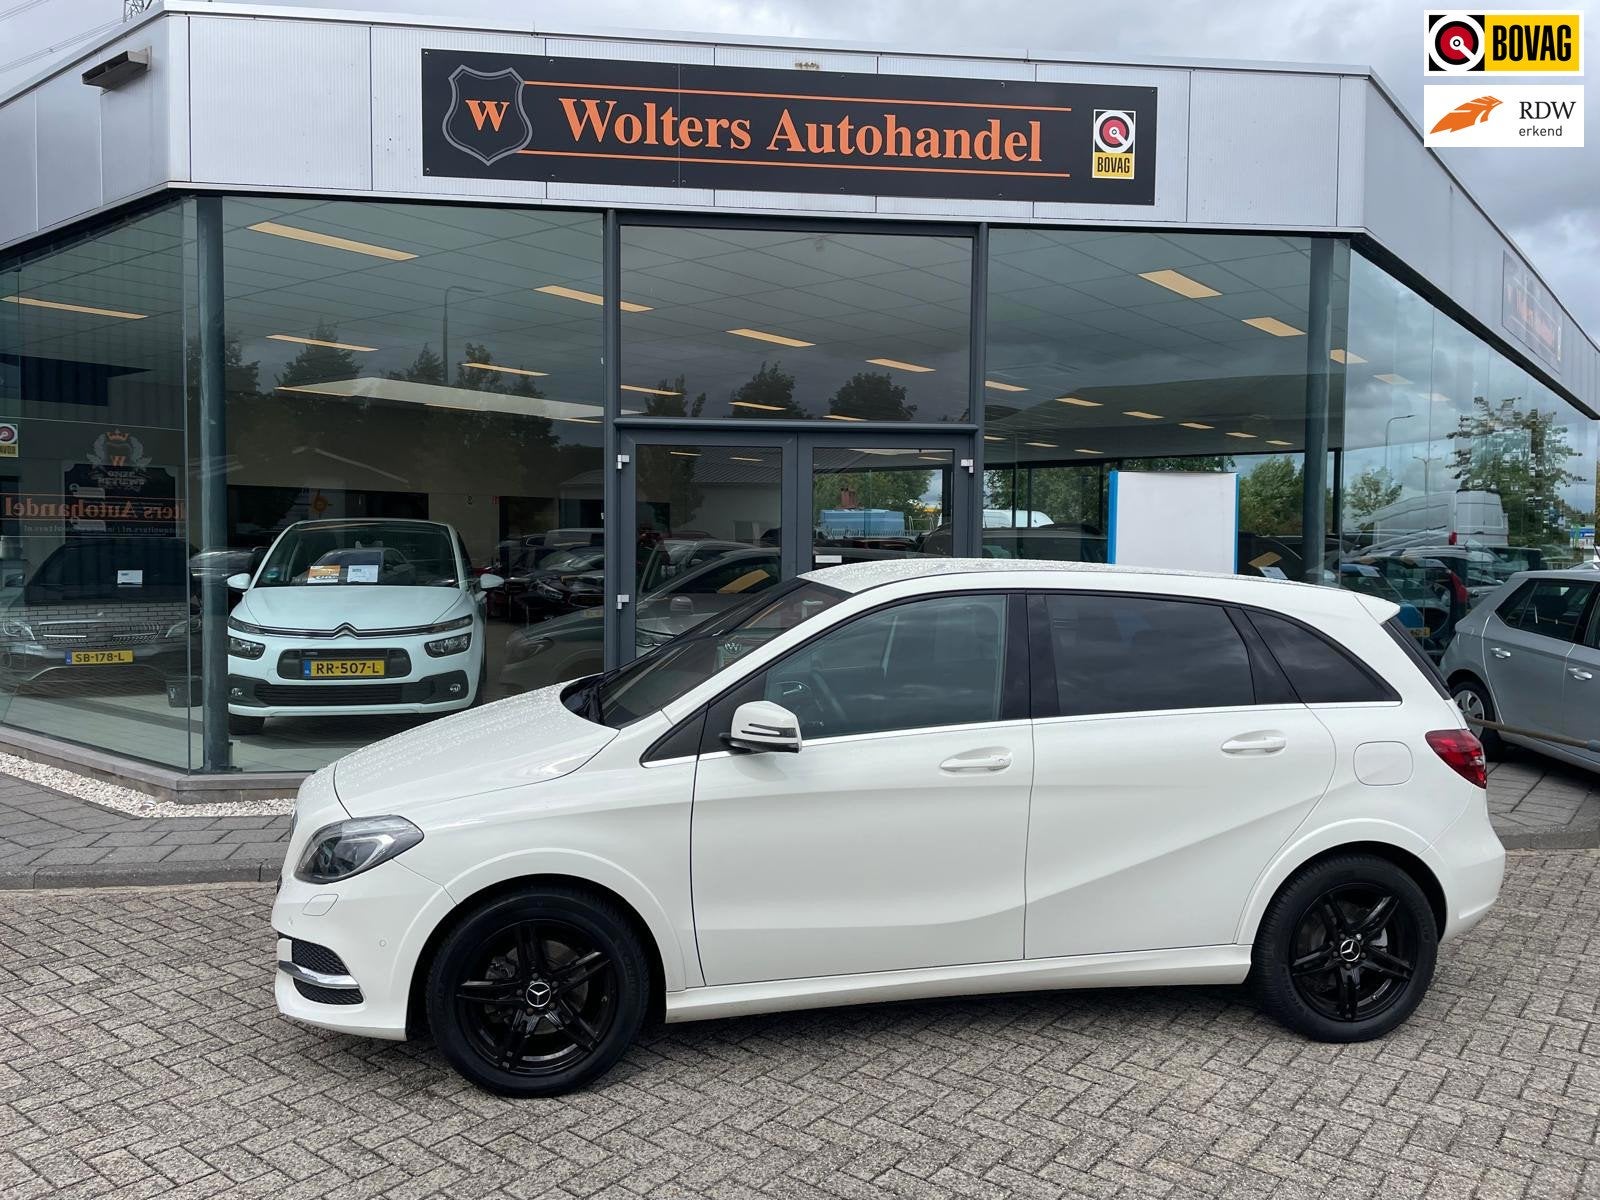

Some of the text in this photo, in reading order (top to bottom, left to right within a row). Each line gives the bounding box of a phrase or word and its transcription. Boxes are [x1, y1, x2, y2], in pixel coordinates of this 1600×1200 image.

[465, 99, 510, 132] W
[558, 97, 1042, 162] Wolters Autohandel
[1096, 155, 1131, 175] BOVAG
[75, 652, 125, 663] SB-178-L
[316, 662, 380, 675] RR-507-L
